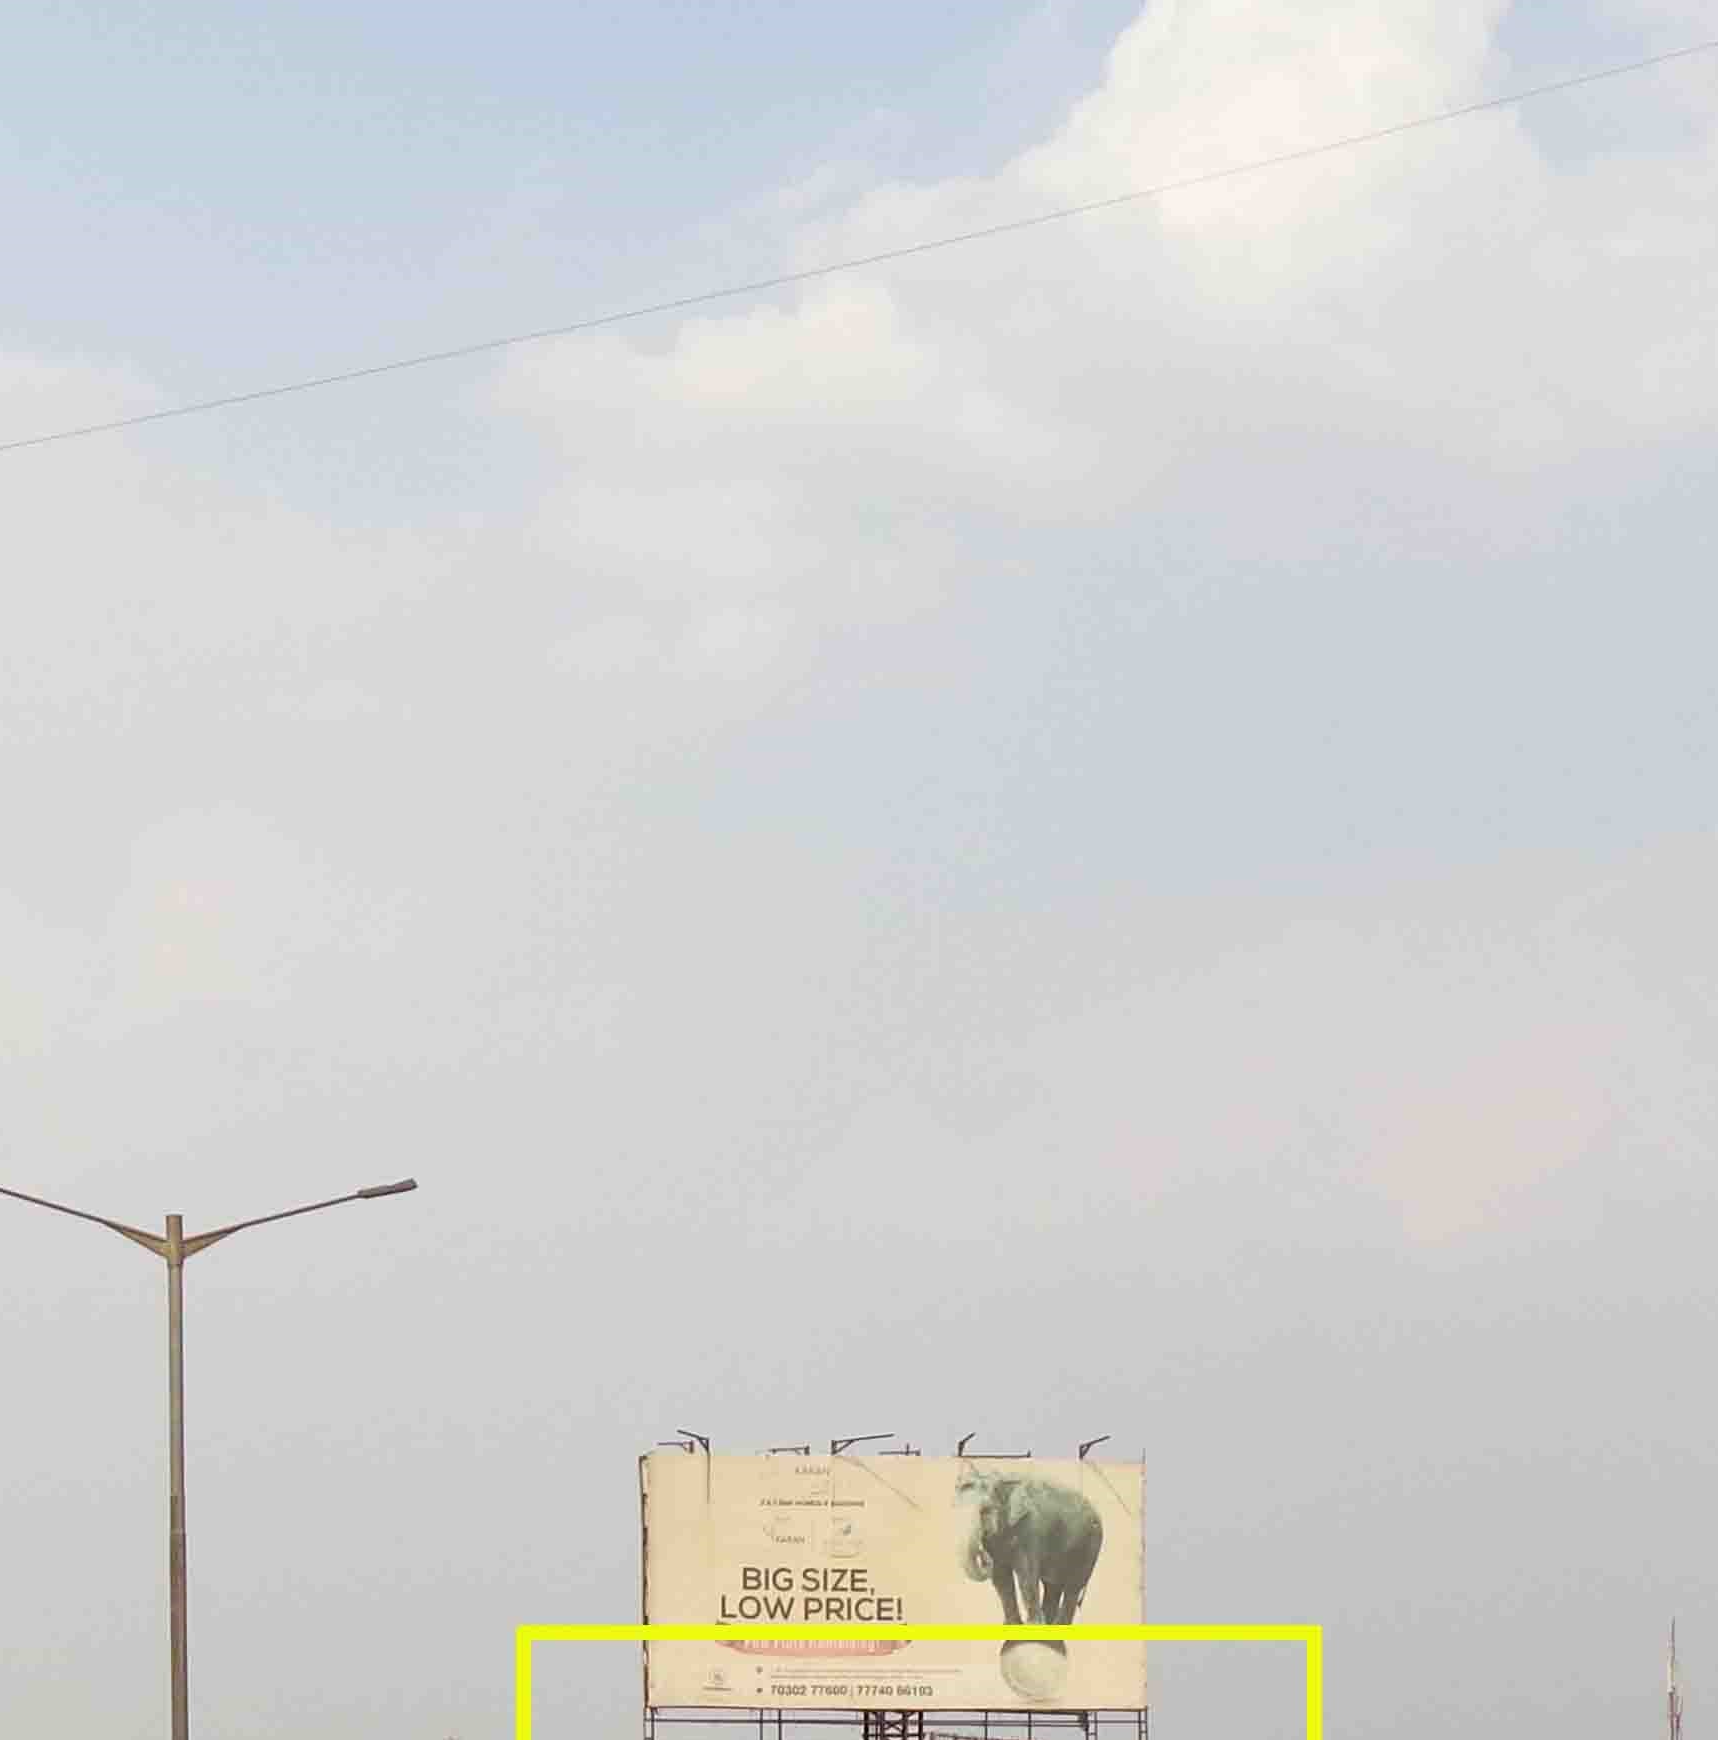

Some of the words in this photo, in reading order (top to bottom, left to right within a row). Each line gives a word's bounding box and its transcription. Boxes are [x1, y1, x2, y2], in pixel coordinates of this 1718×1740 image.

[742, 1567, 794, 1591] BIG
[801, 1568, 875, 1596] SIZE,
[721, 1595, 794, 1620] LOW
[804, 1597, 903, 1621] PRICE!
